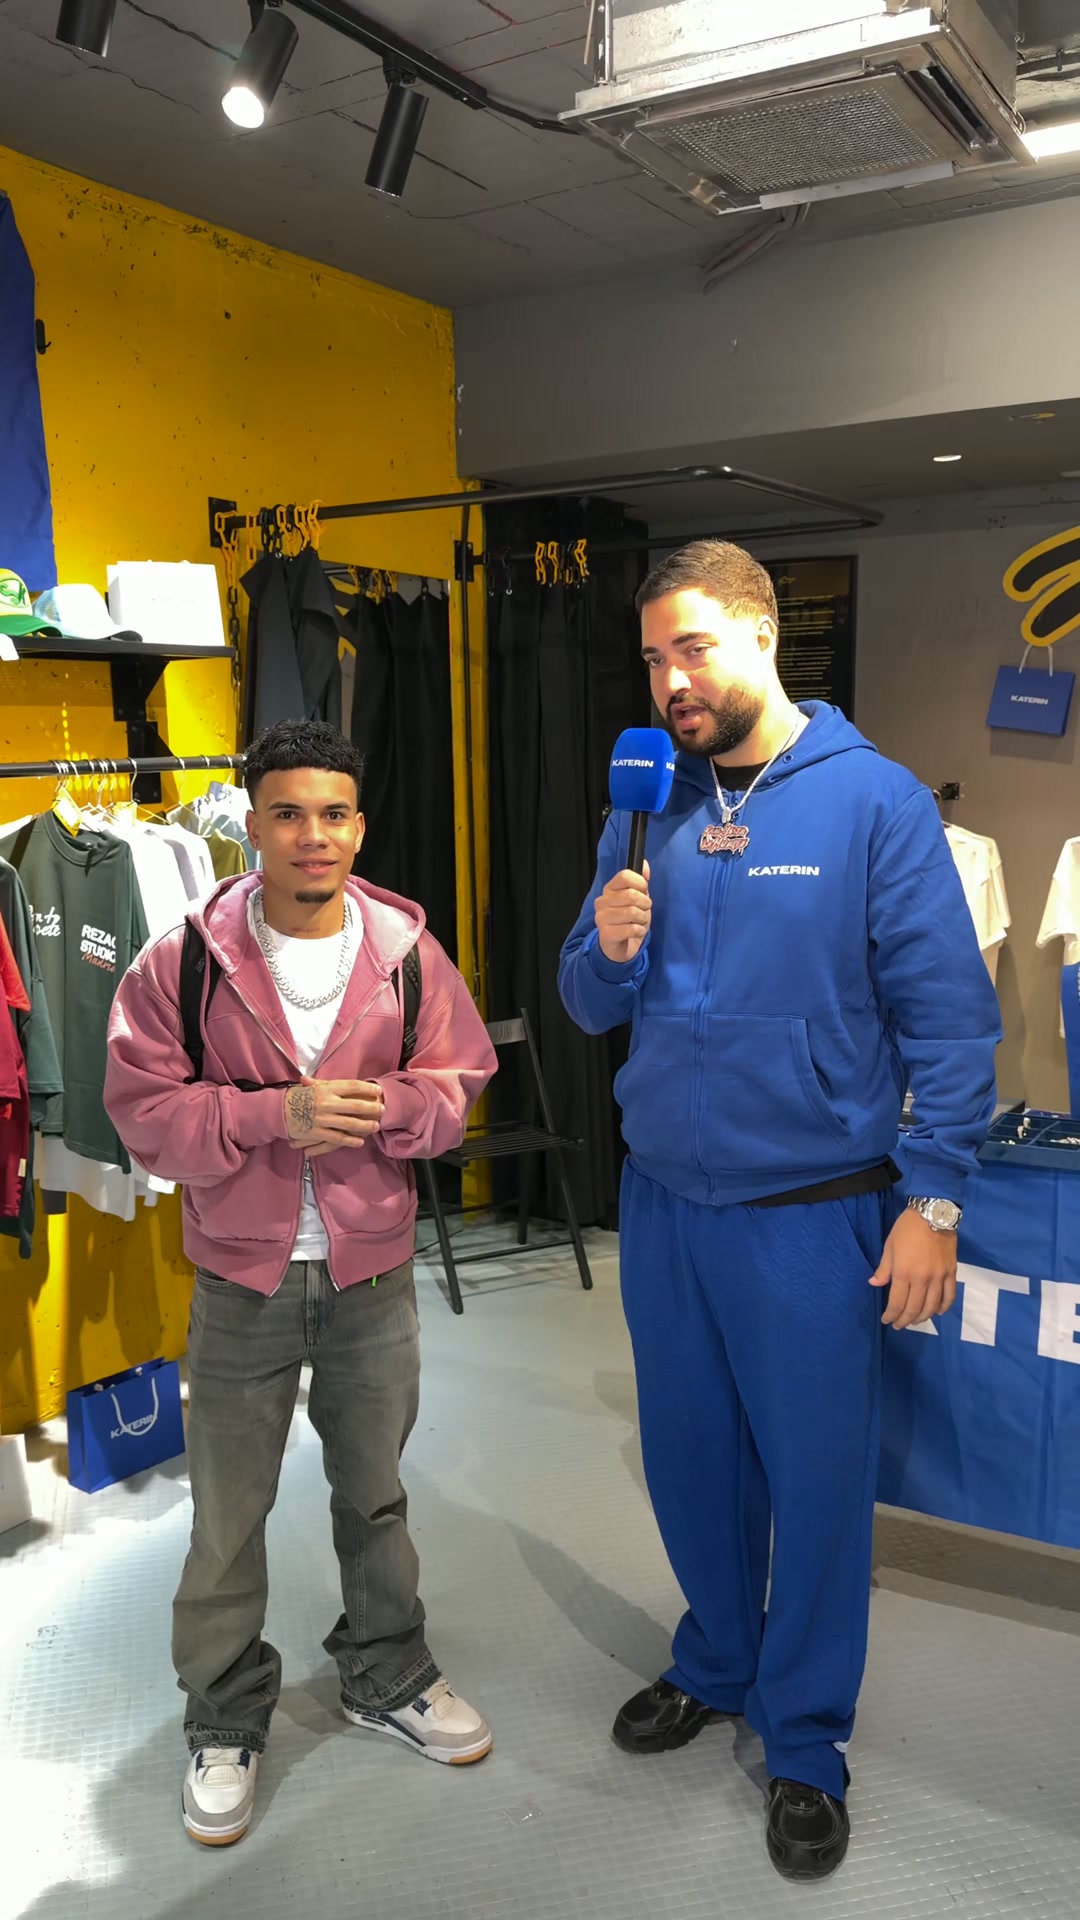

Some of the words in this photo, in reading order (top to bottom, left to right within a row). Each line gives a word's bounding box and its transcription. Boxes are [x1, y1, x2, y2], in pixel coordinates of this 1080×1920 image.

[1010, 694, 1049, 705] KATERIN
[612, 759, 654, 768] KATERIN
[748, 865, 820, 877] KATERIN
[905, 1262, 1080, 1365] TE
